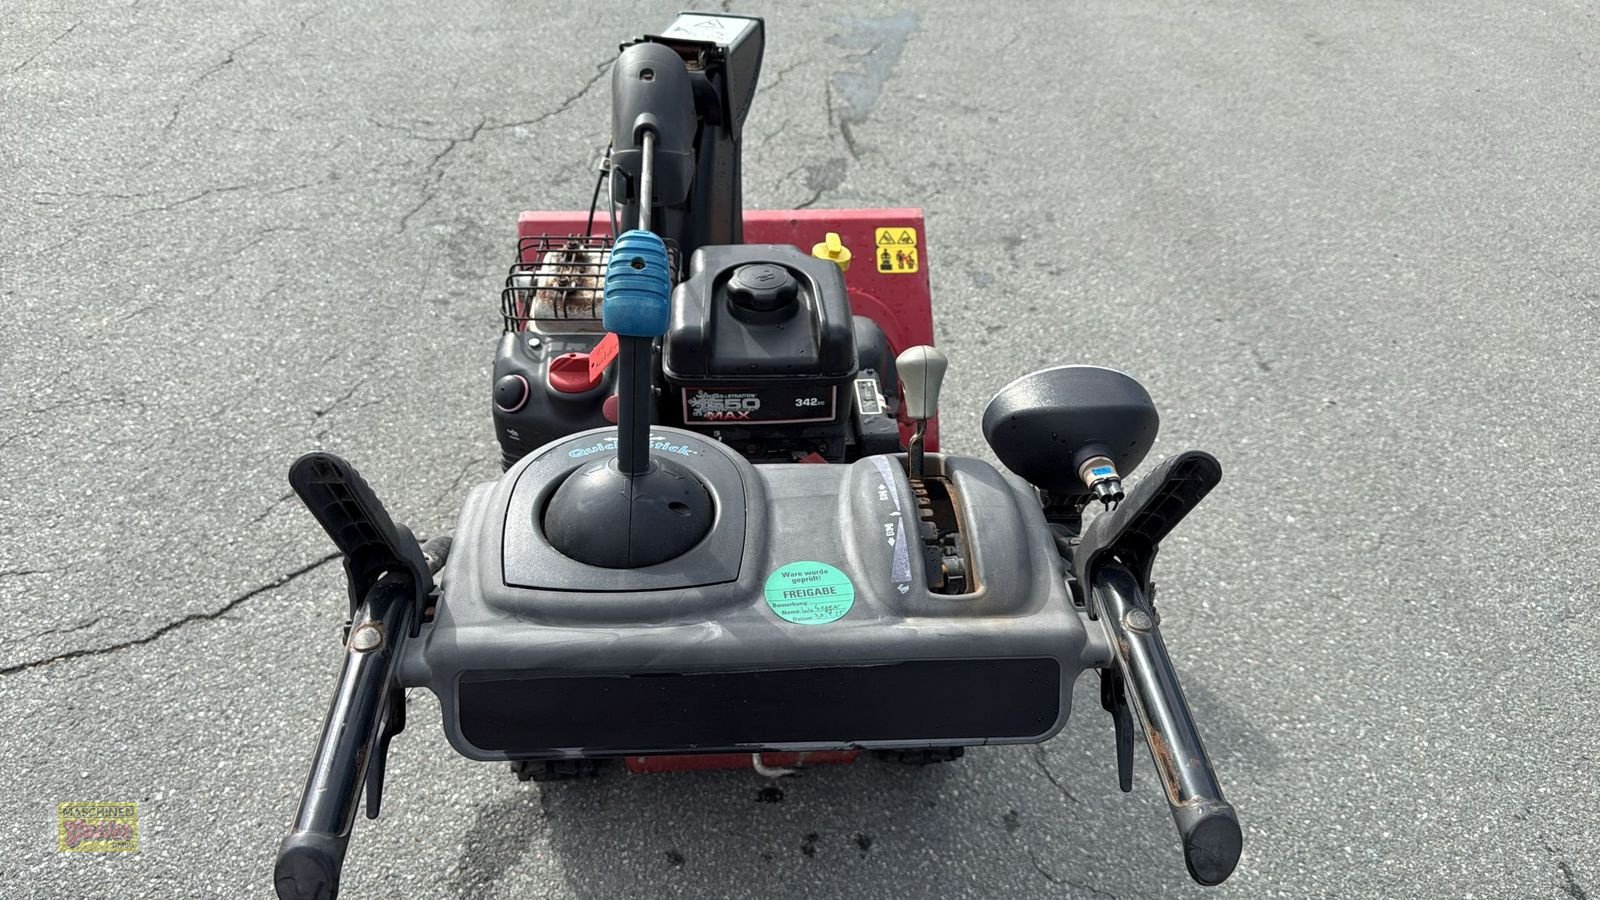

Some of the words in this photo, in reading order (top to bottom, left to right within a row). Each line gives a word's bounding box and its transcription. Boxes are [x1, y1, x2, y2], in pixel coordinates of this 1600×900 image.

[804, 569, 829, 578] wurde
[791, 575, 822, 584] geprüft!
[783, 586, 837, 599] FREIGABE
